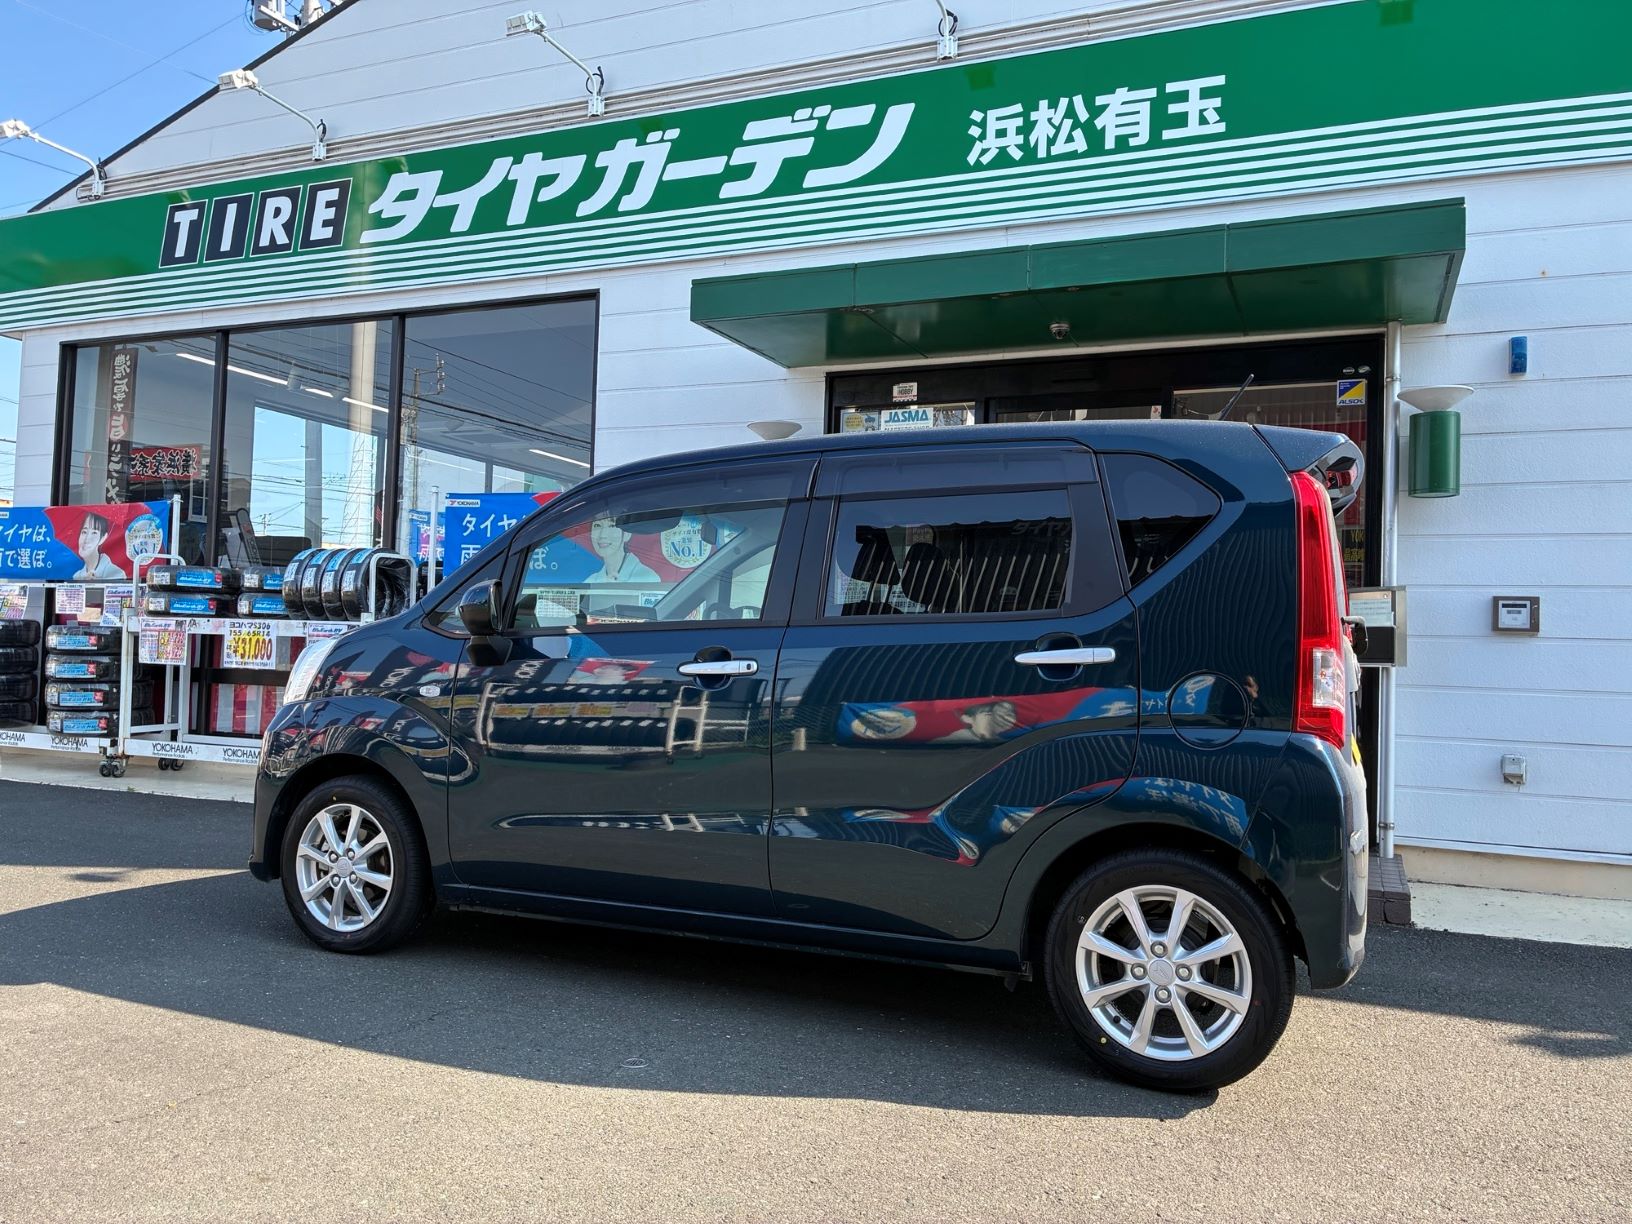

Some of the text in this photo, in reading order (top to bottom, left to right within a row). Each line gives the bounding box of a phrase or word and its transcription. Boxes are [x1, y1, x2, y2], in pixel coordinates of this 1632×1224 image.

[967, 75, 1226, 166] 浜松有玉
[360, 102, 916, 244] タイヤガーデン
[172, 187, 344, 260] TIRE
[884, 409, 929, 423] JASMA
[0, 524, 51, 542] イヤは、
[462, 513, 527, 537] タイヤ
[0, 548, 53, 568] で選ぼ。
[229, 621, 271, 629] ヨコハマS306
[51, 736, 89, 748] YOKOHAMA
[152, 743, 193, 754] YOKOHAMA
[223, 748, 261, 760] YOKOHAM
